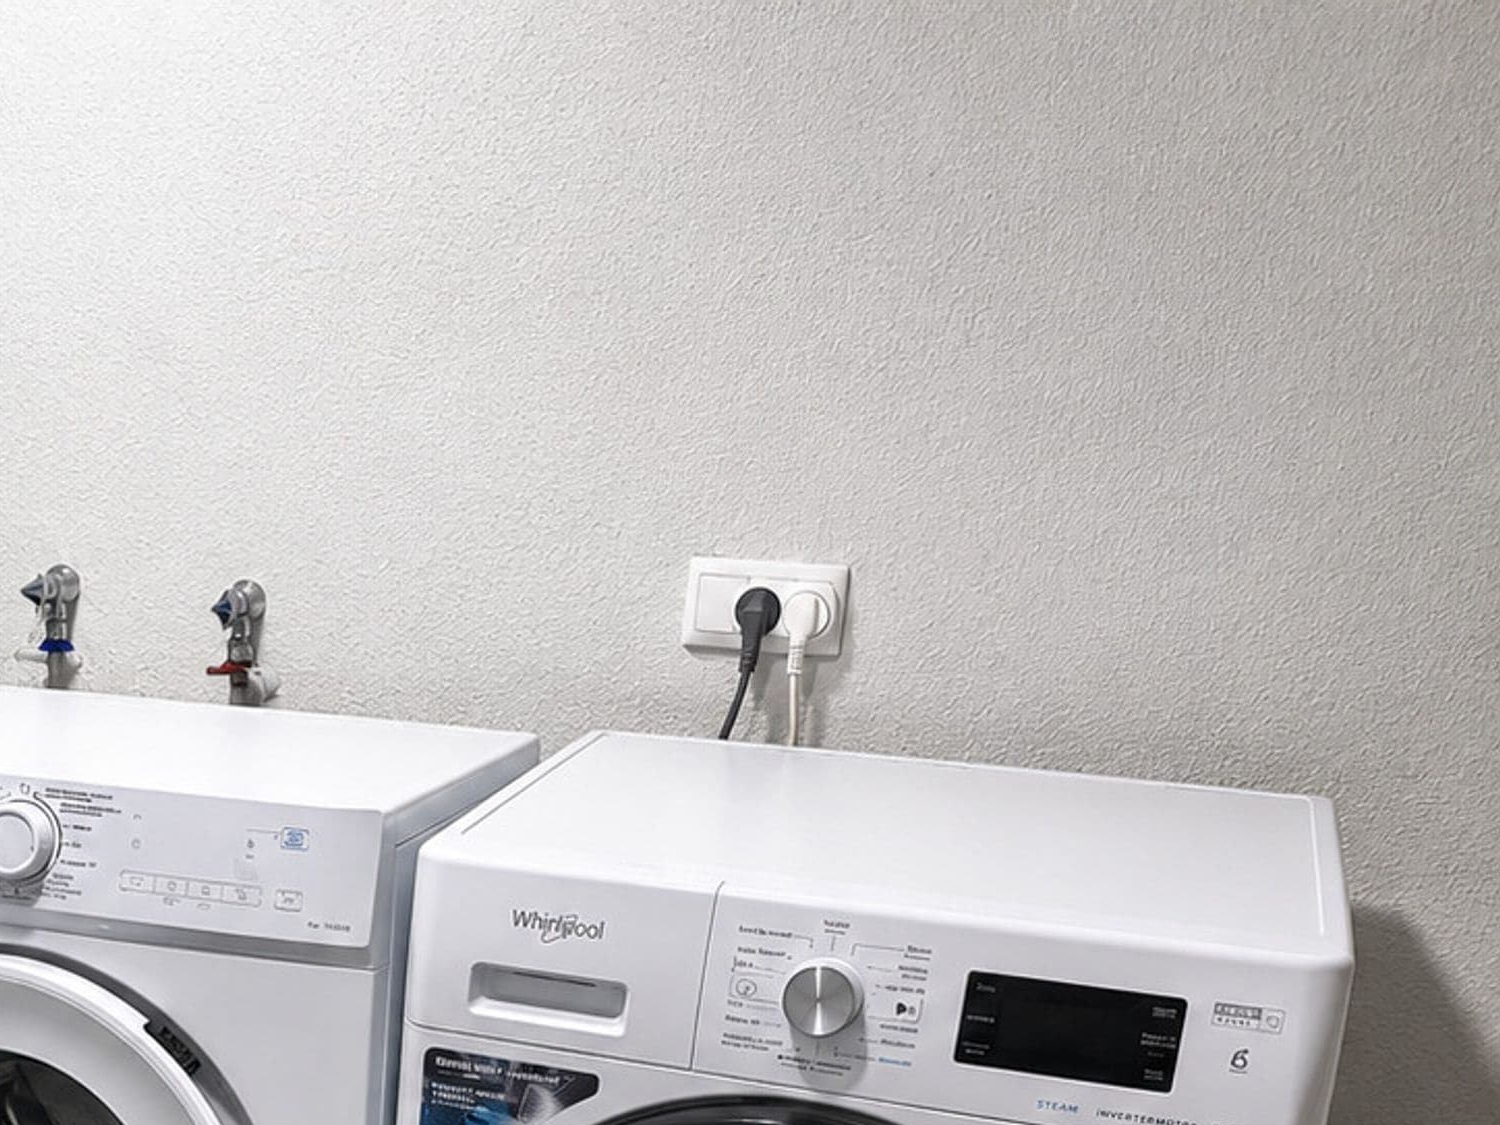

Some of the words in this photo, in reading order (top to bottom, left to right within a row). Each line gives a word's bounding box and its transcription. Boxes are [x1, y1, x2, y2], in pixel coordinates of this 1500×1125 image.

[512, 908, 606, 943] Whirlpool
[1230, 1047, 1249, 1070] 6
[1036, 1099, 1080, 1115] STEAM
